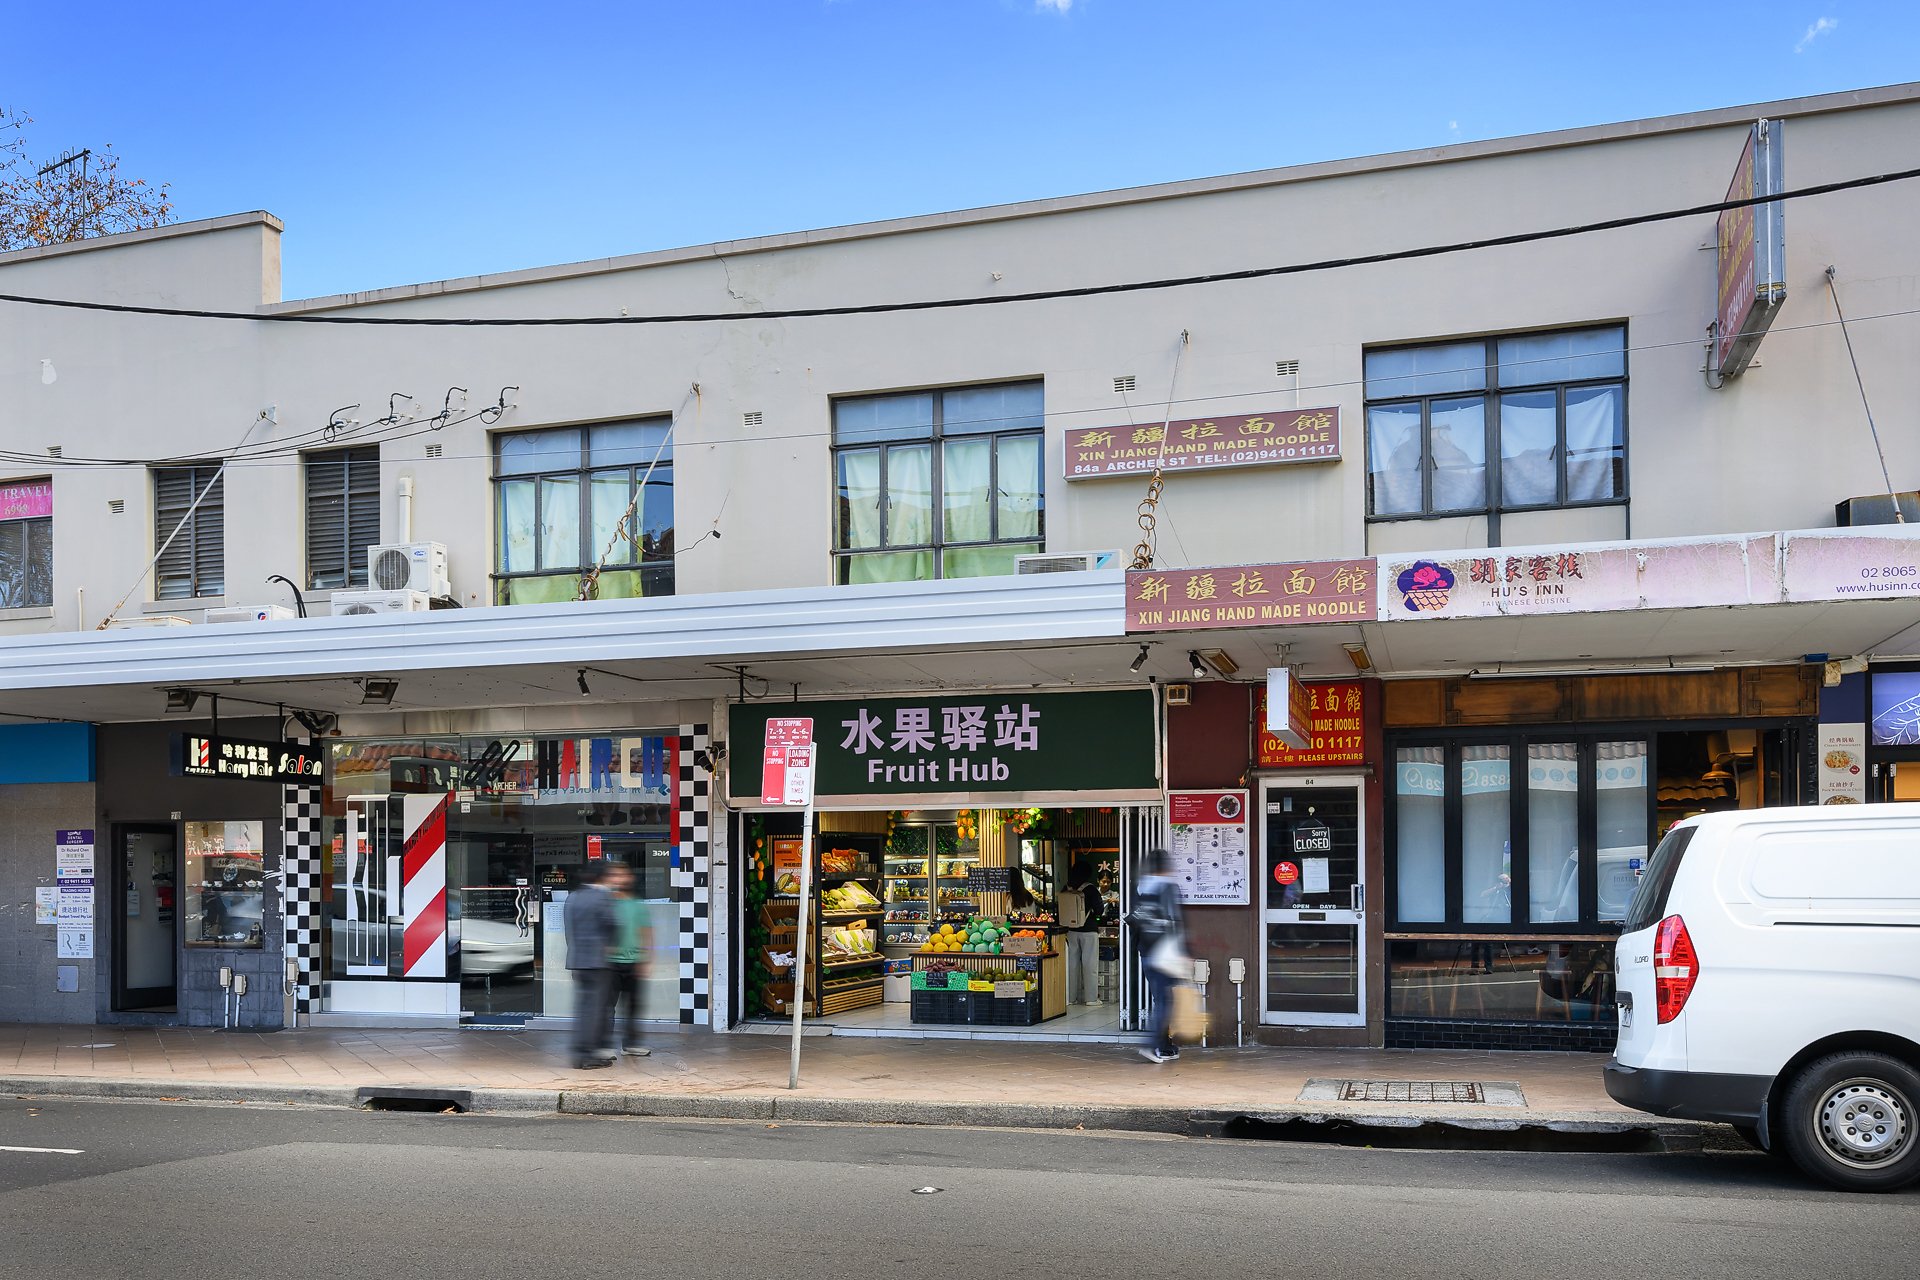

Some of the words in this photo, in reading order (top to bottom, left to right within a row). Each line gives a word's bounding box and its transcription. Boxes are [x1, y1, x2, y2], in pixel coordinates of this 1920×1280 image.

[1078, 451, 1105, 462] XIN
[1110, 447, 1158, 459] JIANG
[1164, 443, 1207, 455] HAND
[1213, 438, 1257, 451] MADE
[1263, 432, 1330, 447] NOODLE
[1074, 464, 1100, 474] 84a
[1106, 457, 1165, 472] ARCHER
[1170, 456, 1187, 466] ST
[1194, 454, 1227, 465] TEL:
[1299, 445, 1336, 457] 1117
[3, 485, 52, 499] TRAVEL
[1861, 567, 1878, 578] 02
[1882, 566, 1917, 577] 8065
[1491, 586, 1528, 597] HU'S
[1536, 584, 1564, 595] INN
[1481, 598, 1530, 607] TAIWANESE
[1534, 596, 1571, 604] CUISINE
[1138, 611, 1163, 625] XIN
[1168, 608, 1211, 623] JIANG
[1216, 606, 1255, 621] HAND
[1261, 604, 1301, 619] MADE
[1307, 600, 1367, 616] NOODLE
[840, 704, 1041, 754] 水果驿站
[1315, 719, 1333, 731] MADE
[1334, 718, 1360, 731] NOODLE
[1328, 736, 1362, 748] 1117
[789, 750, 810, 758] LOADING
[278, 753, 322, 776] Salon
[791, 758, 807, 767] ZONE
[868, 758, 940, 783] Fruit
[948, 757, 1010, 782] Hub
[1311, 829, 1327, 838] Sorry
[1296, 838, 1329, 850] CLOSED
